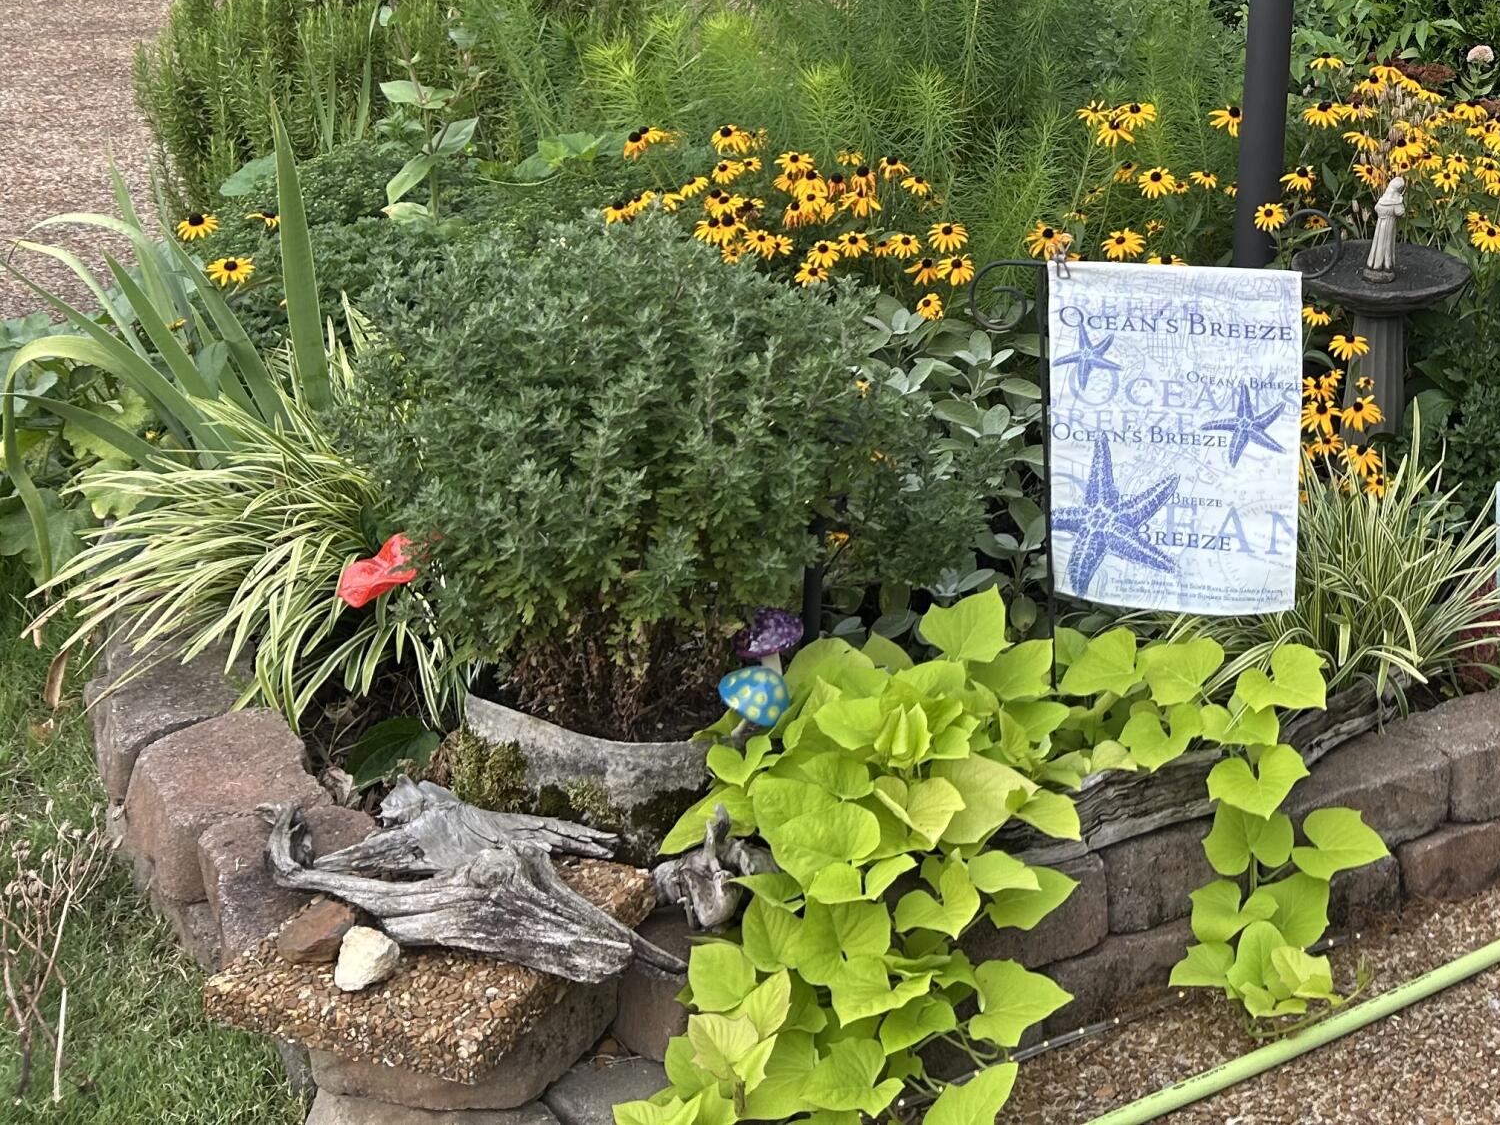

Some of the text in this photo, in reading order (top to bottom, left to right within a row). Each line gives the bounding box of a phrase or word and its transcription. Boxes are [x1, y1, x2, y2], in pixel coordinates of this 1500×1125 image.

[1059, 305, 1293, 341] OCEAN'S BREEZE
[1187, 371, 1243, 389] OCEAN'S
[1051, 422, 1228, 448] OCEAN'S BREEZE
[1170, 491, 1223, 508] BREEZE
